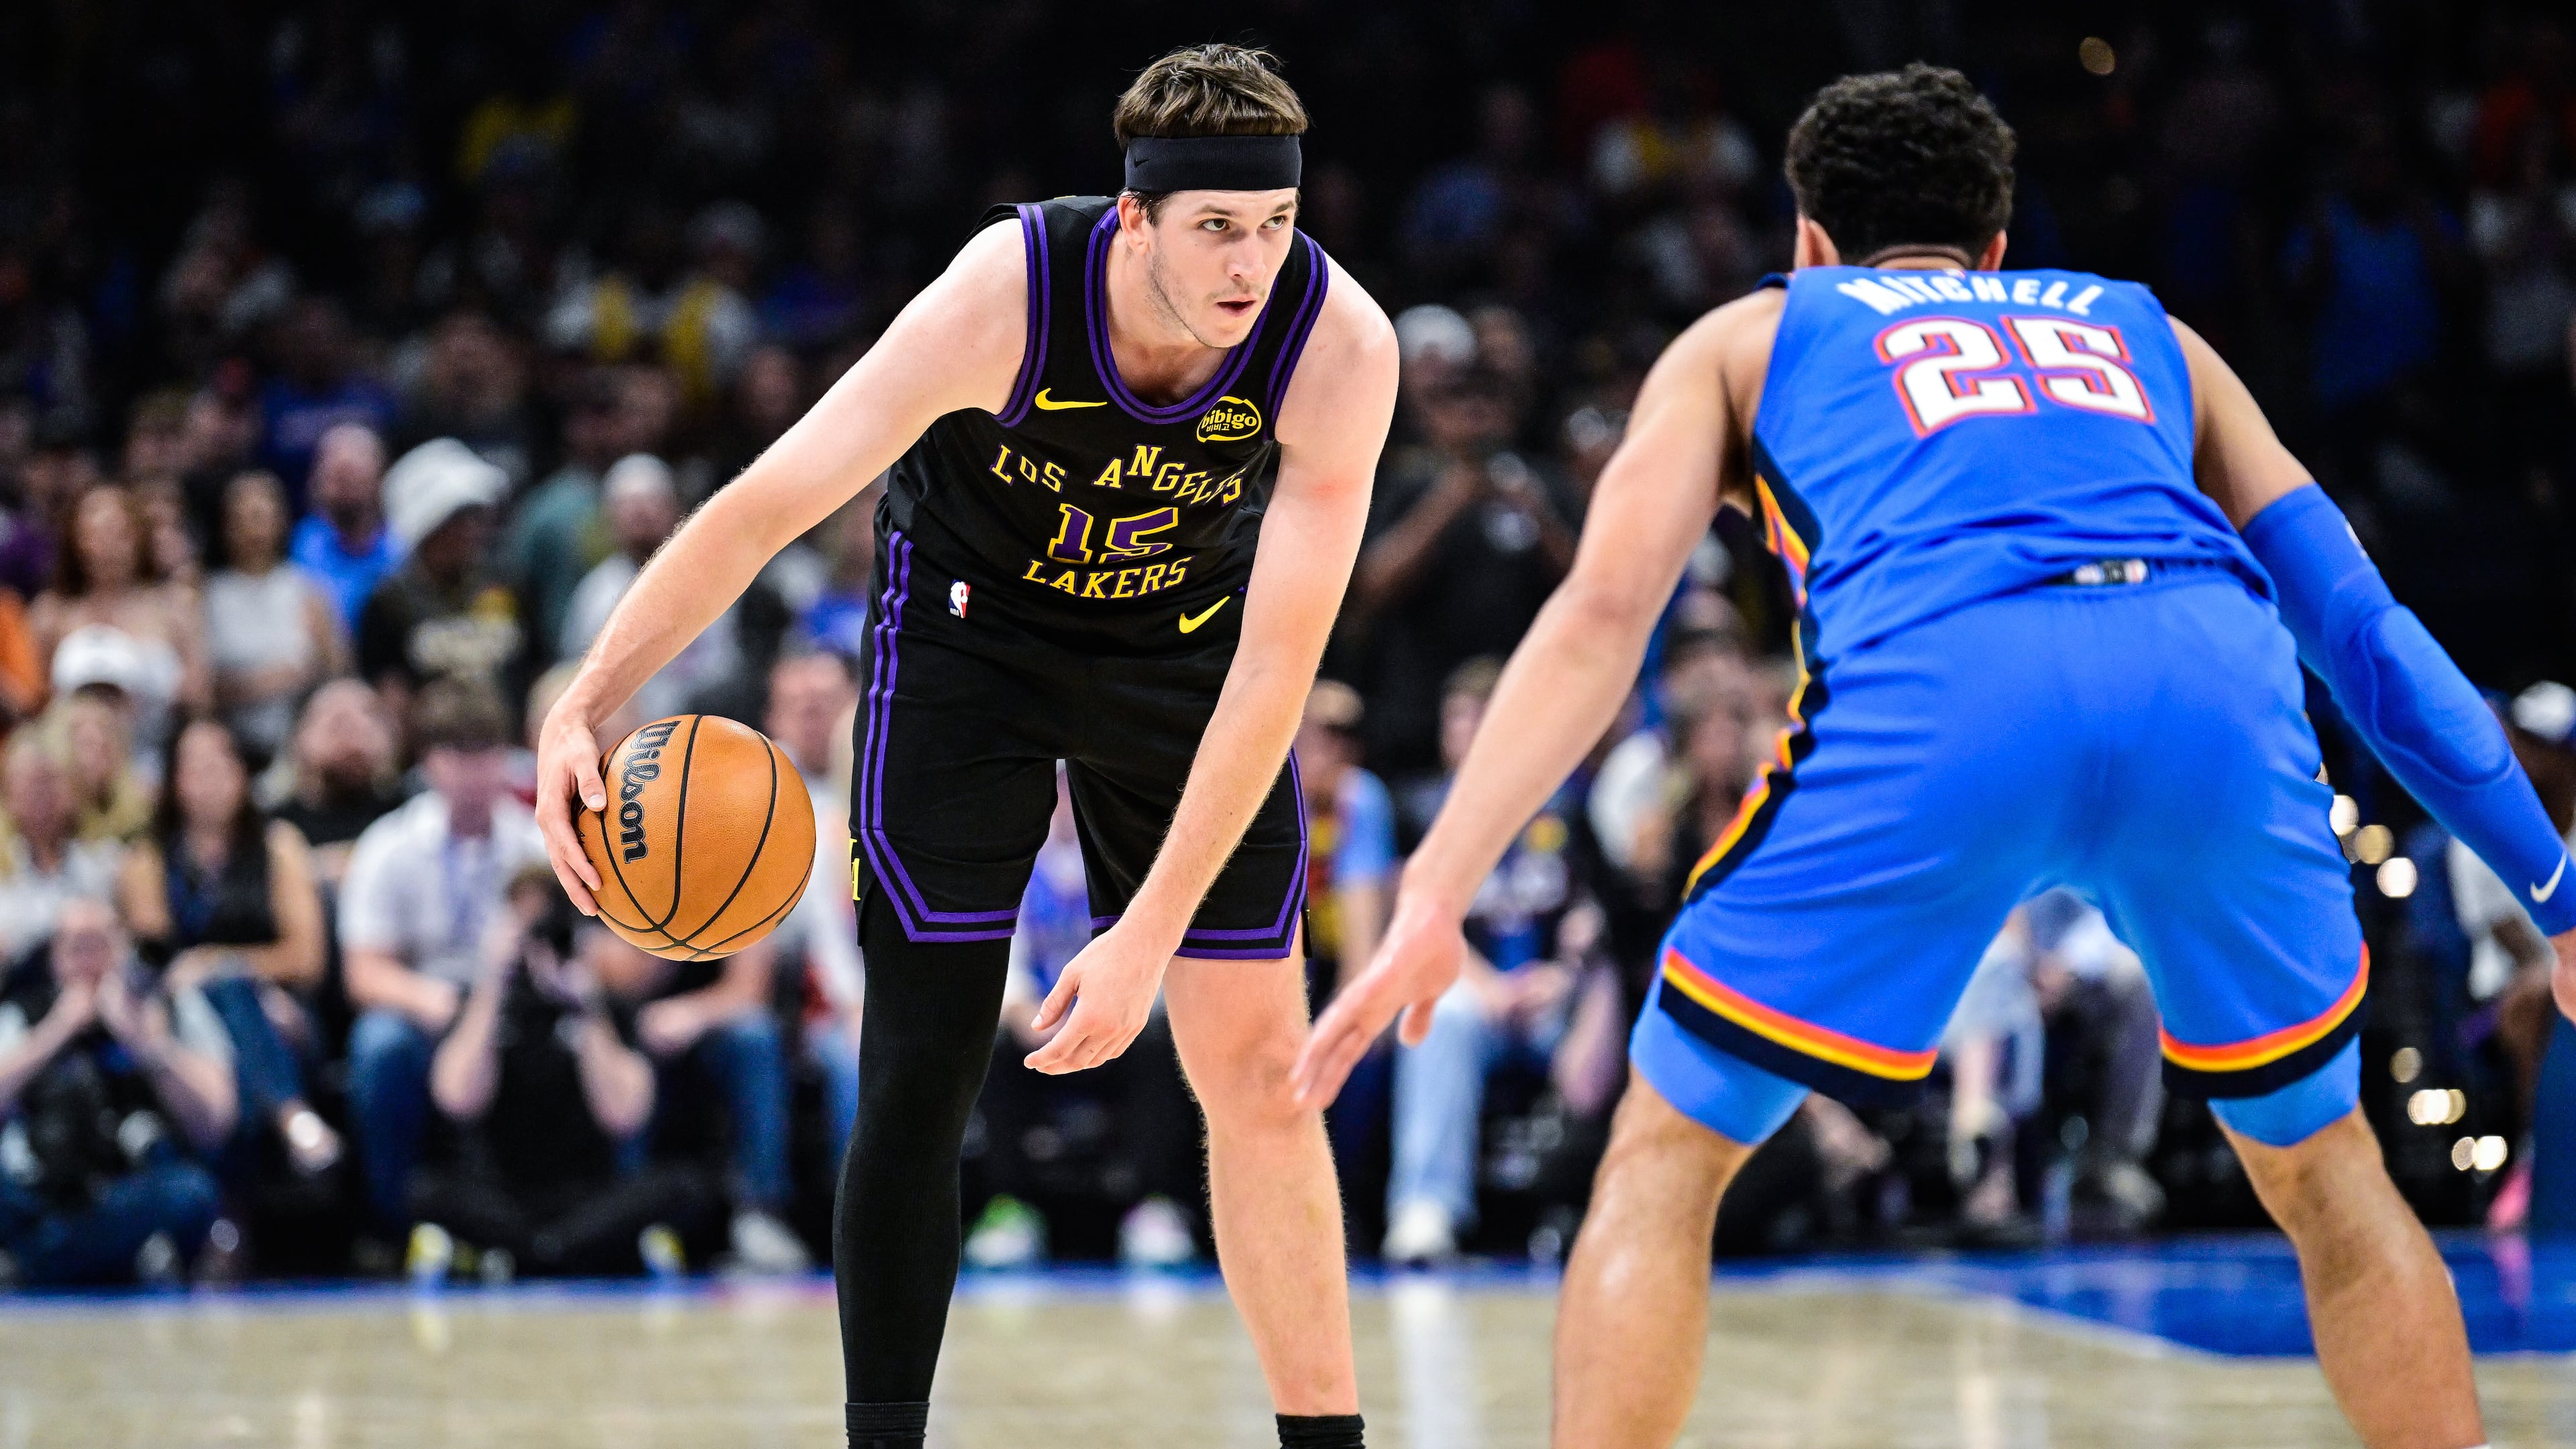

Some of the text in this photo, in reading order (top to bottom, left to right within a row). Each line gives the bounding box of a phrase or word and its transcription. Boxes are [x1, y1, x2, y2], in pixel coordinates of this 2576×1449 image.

[1836, 275, 2104, 316] MITCHELL
[1874, 315, 2155, 439] 25
[1201, 408, 1257, 429] bibigo
[989, 442, 1246, 507] LOS ANGELES
[1047, 503, 1179, 564] 15
[1022, 555, 1195, 600] LAKERS
[619, 720, 682, 865] Wilson
